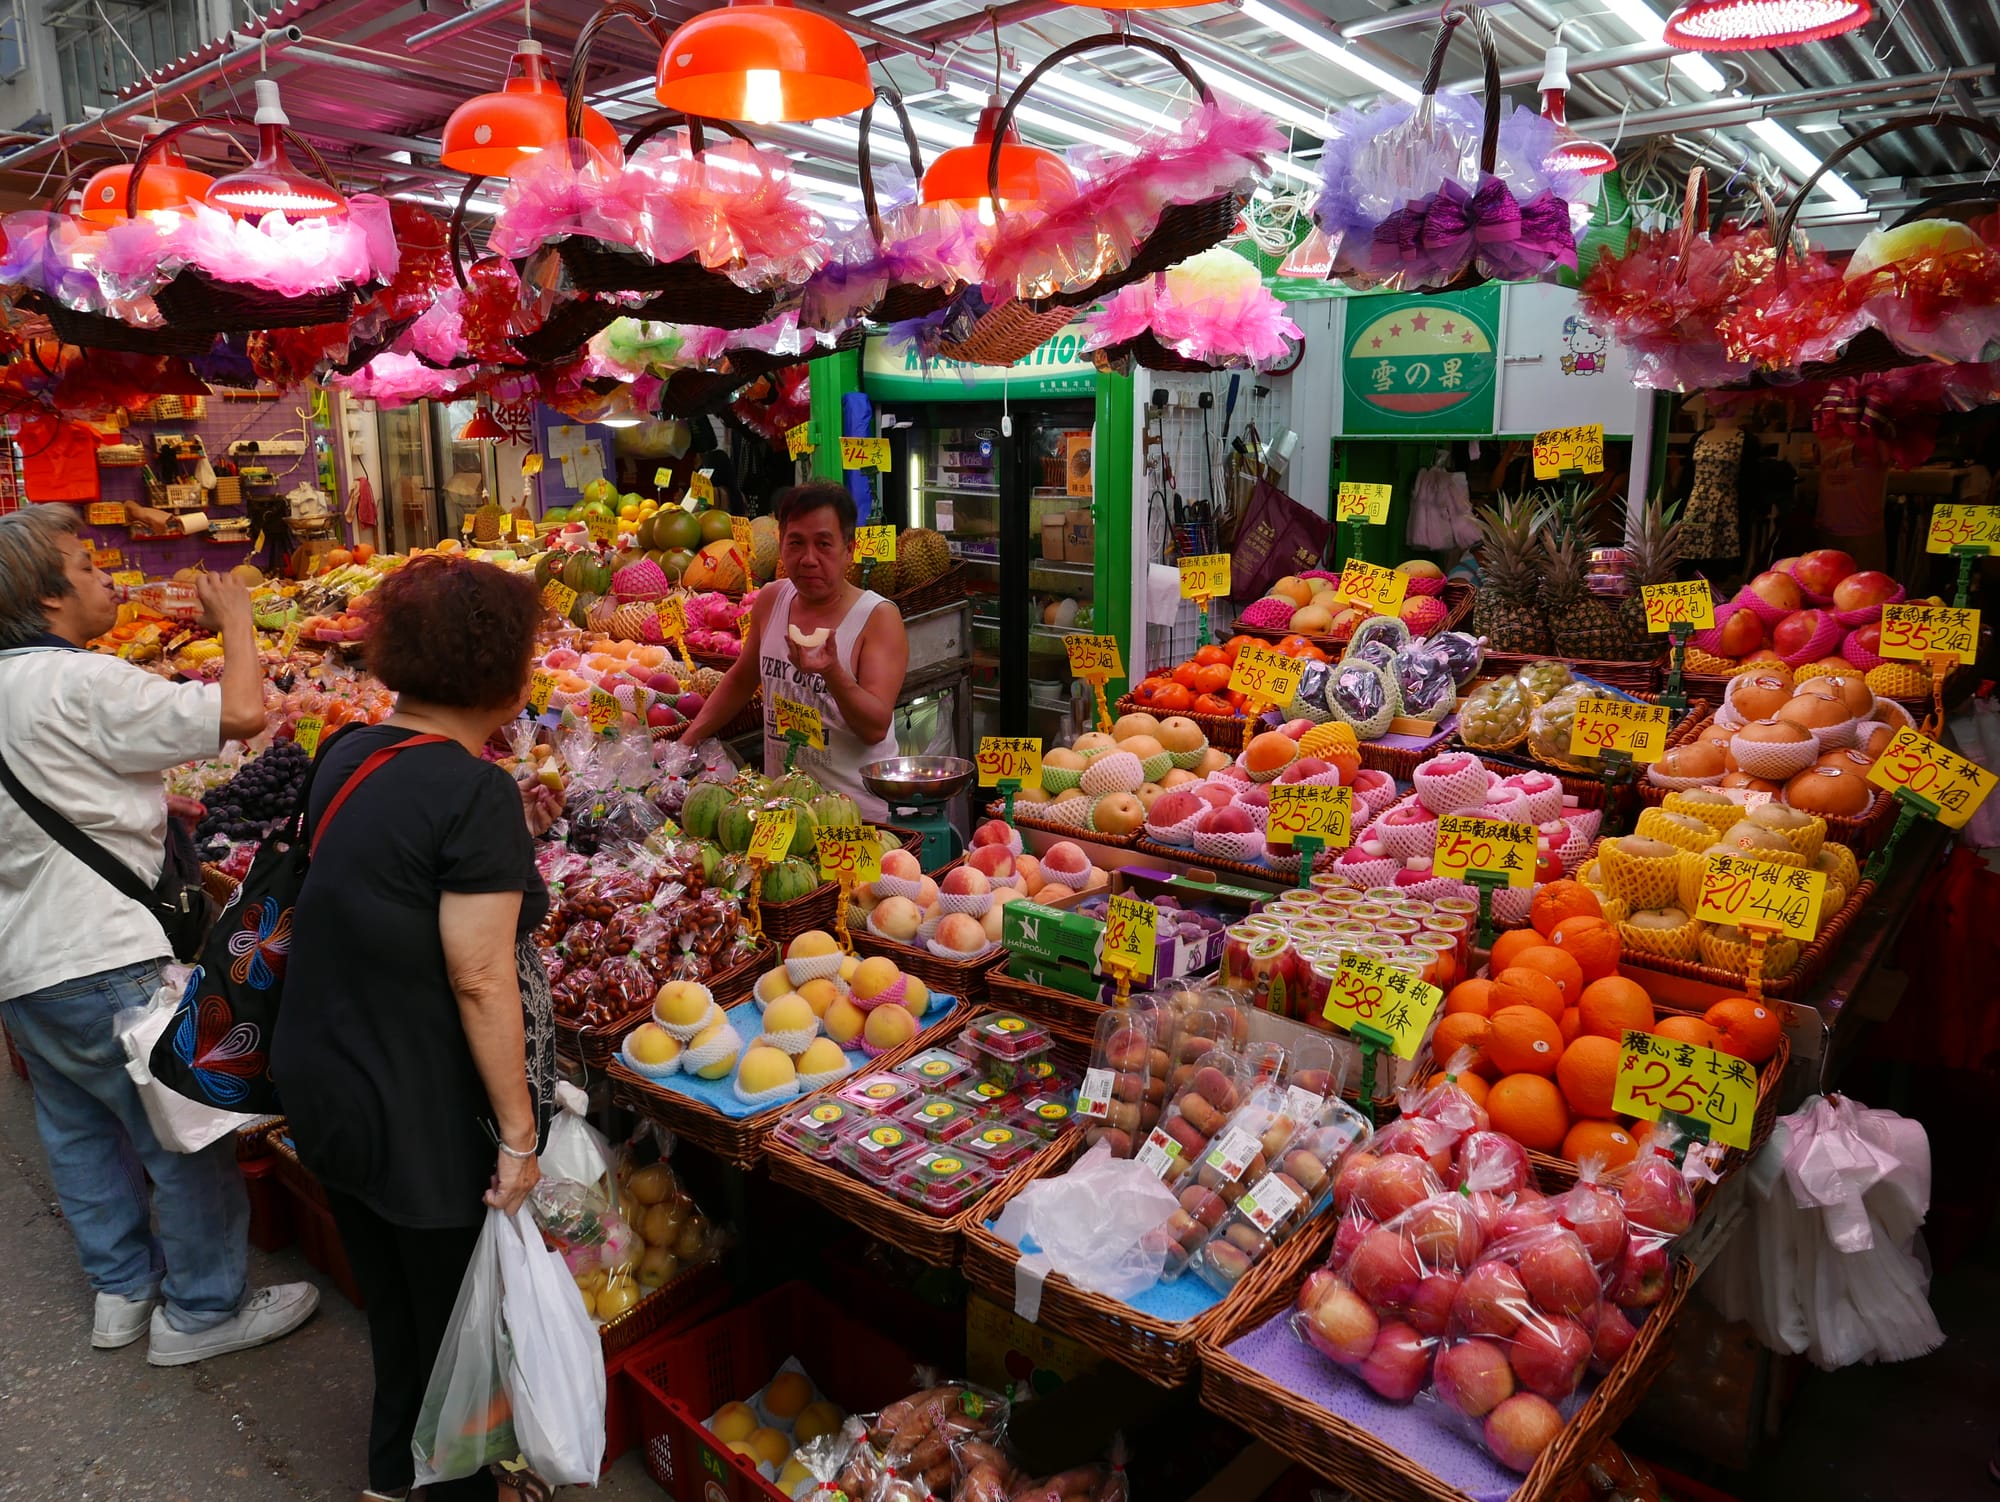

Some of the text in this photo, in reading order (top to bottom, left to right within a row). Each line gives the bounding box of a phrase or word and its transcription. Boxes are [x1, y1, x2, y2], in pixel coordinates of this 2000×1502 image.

[1371, 358, 1463, 391] 雪の果
[762, 655, 791, 681] VERY
